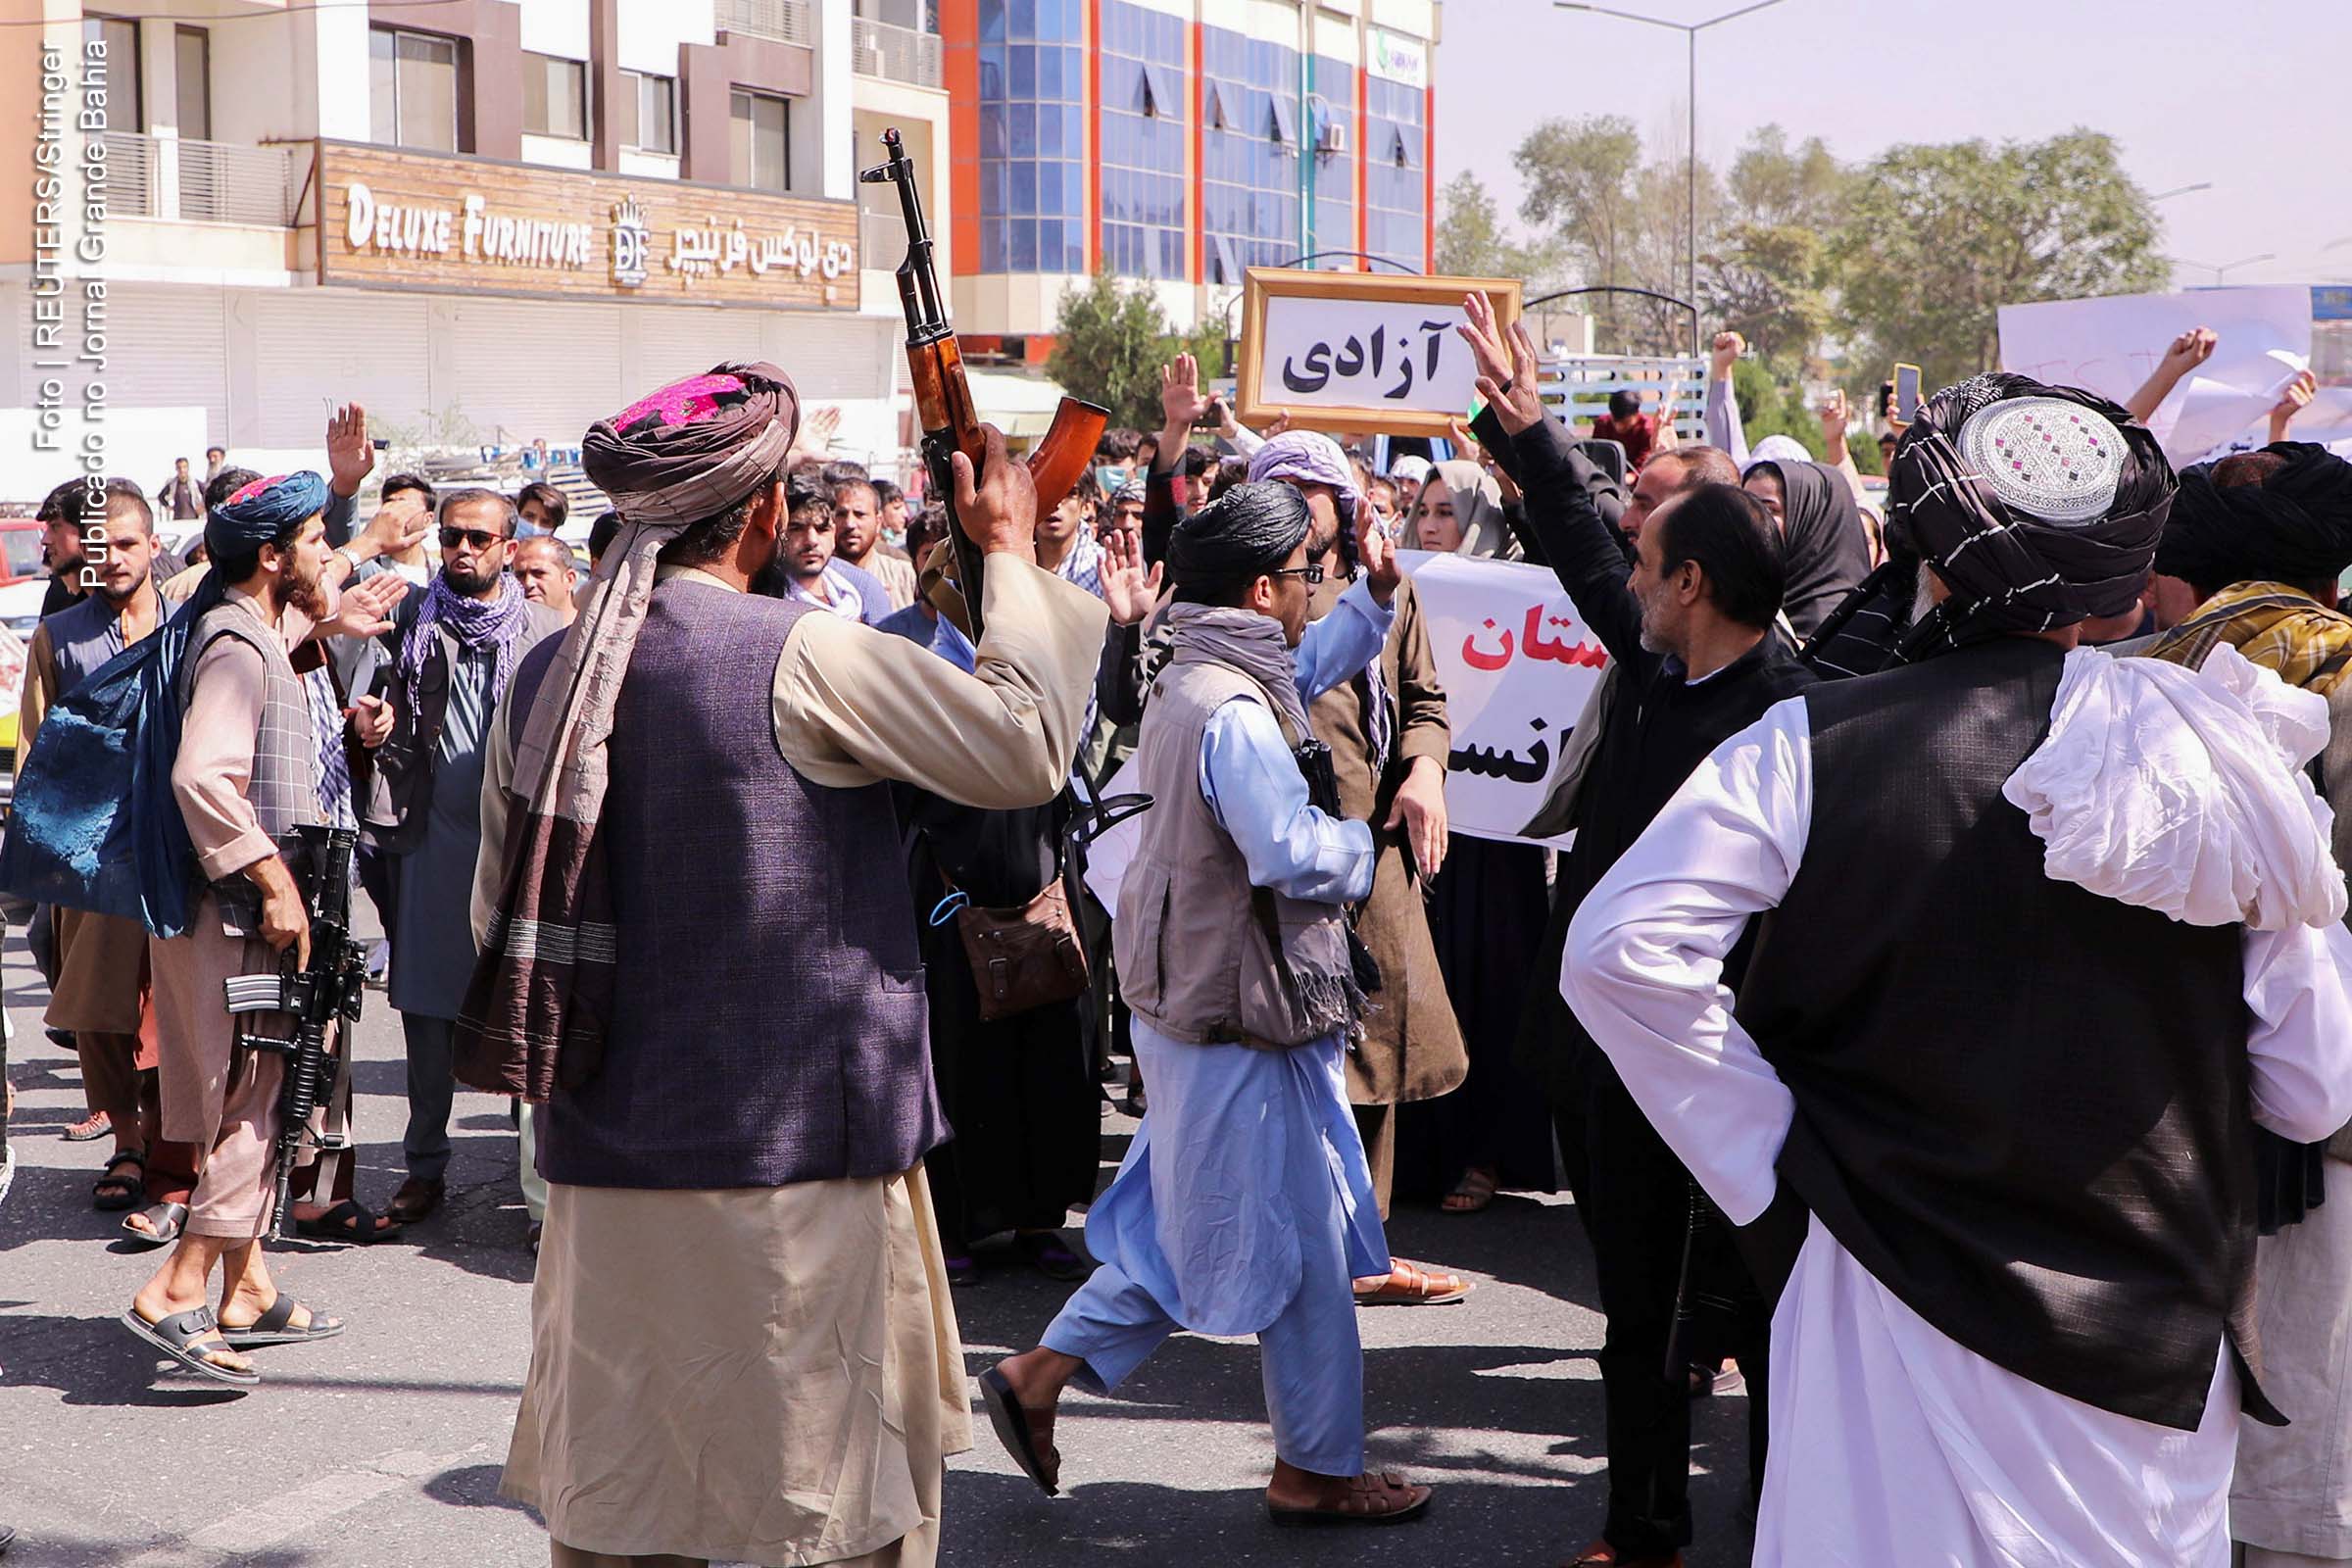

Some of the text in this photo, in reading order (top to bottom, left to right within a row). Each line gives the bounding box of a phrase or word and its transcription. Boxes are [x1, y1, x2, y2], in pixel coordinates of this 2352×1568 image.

[348, 182, 593, 266] DELUXE FURNITURE
[1282, 319, 1453, 400] آزادی
[1461, 604, 1609, 671] ستان
